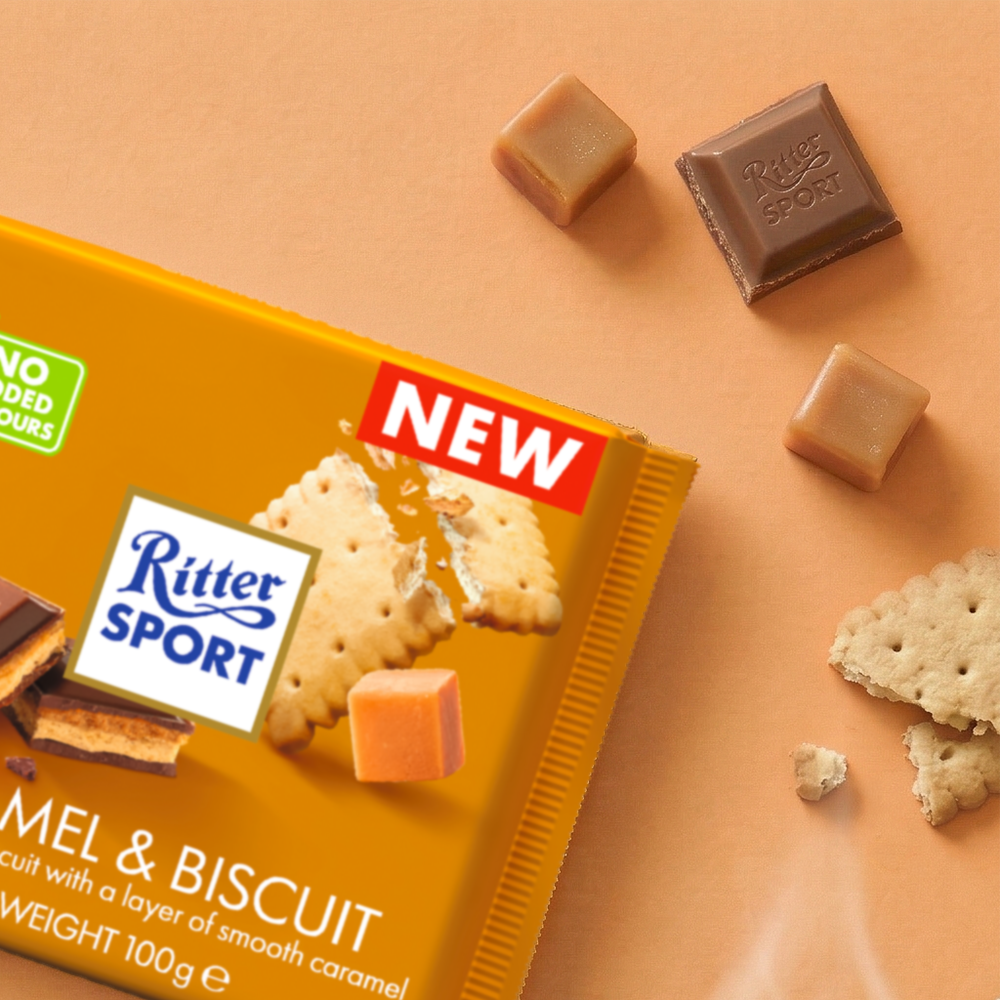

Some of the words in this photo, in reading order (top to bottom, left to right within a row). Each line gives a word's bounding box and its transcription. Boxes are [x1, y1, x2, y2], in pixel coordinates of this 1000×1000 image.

[742, 133, 832, 203] Ritter
[762, 171, 843, 227] SPORT
[381, 380, 584, 491] NEW
[116, 530, 287, 630] Ritter
[100, 602, 265, 686] SPORT
[0, 891, 121, 954] WEIGHT
[124, 934, 195, 989] 100g
[45, 864, 95, 895] with
[99, 885, 116, 902] a
[121, 883, 184, 925] layer
[188, 911, 218, 936] of
[217, 924, 305, 967] smooth
[115, 829, 156, 882] &
[170, 845, 384, 953] BISCUIT
